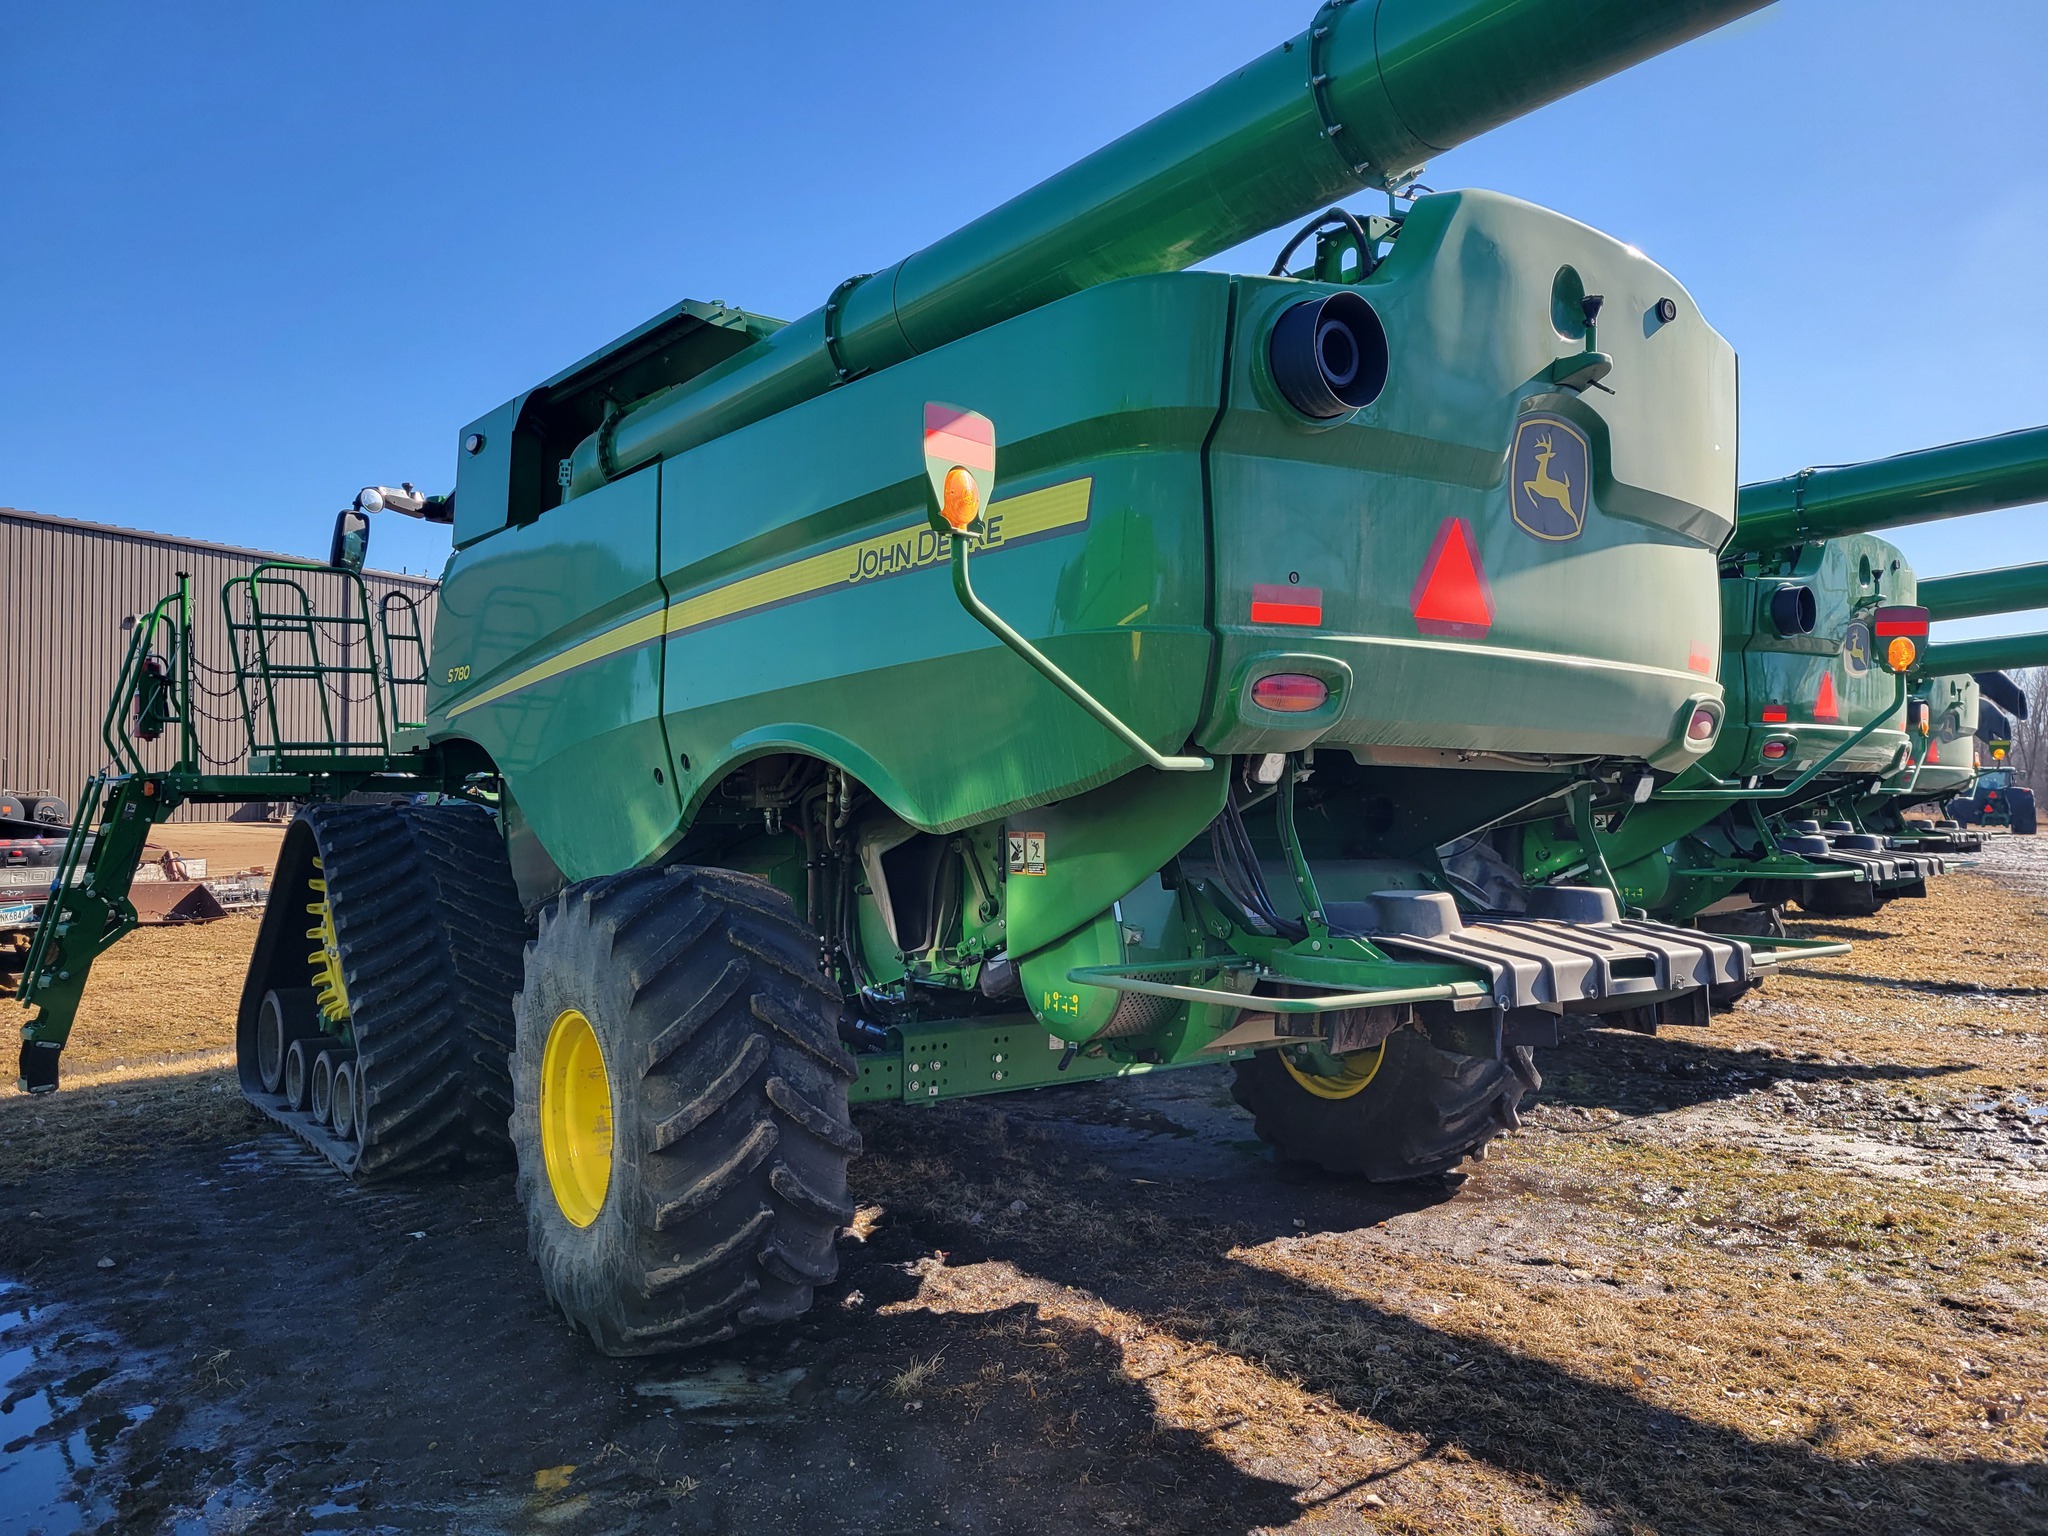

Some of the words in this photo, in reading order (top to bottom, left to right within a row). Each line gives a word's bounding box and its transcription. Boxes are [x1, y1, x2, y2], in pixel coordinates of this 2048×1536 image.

[849, 540, 912, 579] JOHN
[918, 515, 1004, 562] DERE
[447, 664, 471, 683] S780
